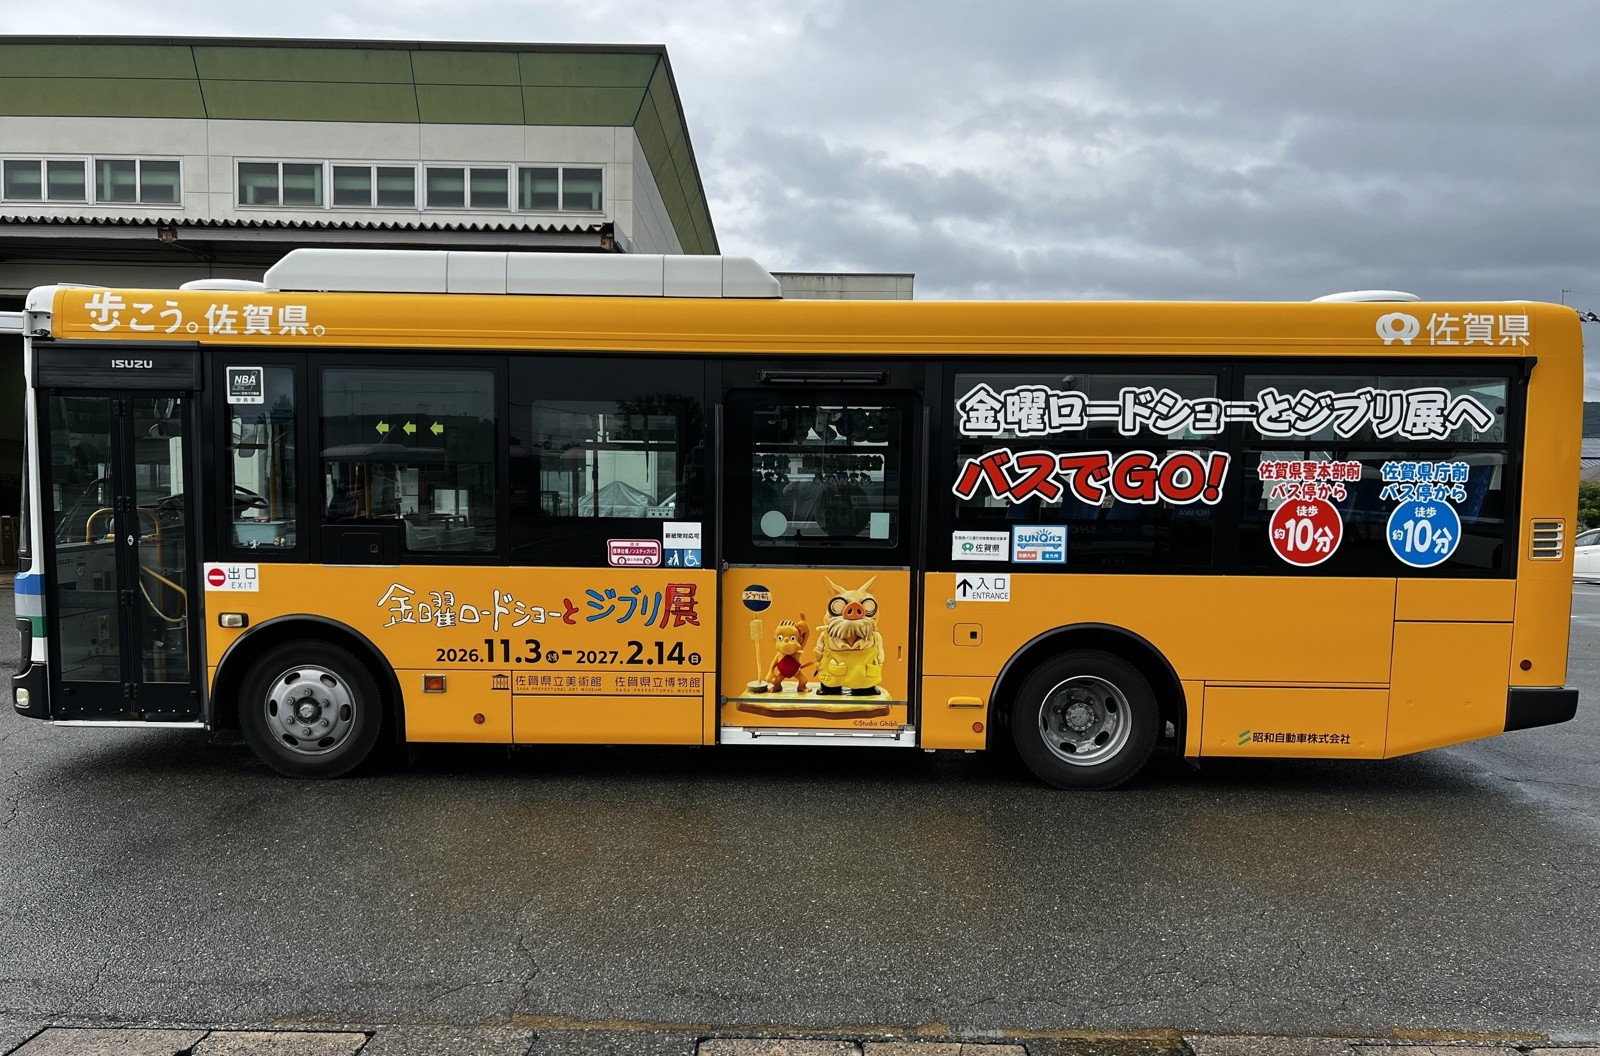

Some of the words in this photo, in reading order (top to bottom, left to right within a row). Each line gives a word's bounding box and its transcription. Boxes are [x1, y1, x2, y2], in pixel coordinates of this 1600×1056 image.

[1426, 313, 1531, 346] 佐賀県
[111, 359, 153, 369] ISUZU
[234, 375, 256, 385] NBA
[956, 383, 1495, 440] 金曜ロードショーとジブリ展へ
[952, 447, 1231, 505] バスでGO!
[1258, 460, 1361, 481] 佐賀県警本部前
[1380, 461, 1469, 483] 佐賀県庁前
[1271, 482, 1347, 502] バス停から
[1380, 483, 1468, 503] バス停から
[1296, 505, 1319, 517] 徒歩
[1414, 506, 1437, 518] 徒歩
[665, 532, 700, 540] 新紙幣対応可
[1273, 517, 1334, 553] 約10分
[1392, 518, 1453, 554] 約10分
[975, 543, 1000, 553] 佐賀県
[228, 566, 256, 579] 出口
[976, 577, 1006, 590] 入口
[972, 591, 1009, 600] ENTRANCE
[377, 582, 701, 632] 金曜ロードショーとジブリ展
[515, 675, 602, 687] 佐賀県立美術館
[615, 676, 700, 688] 佐賀県立博物館
[1252, 732, 1351, 745] 昭和自動車株式会社
